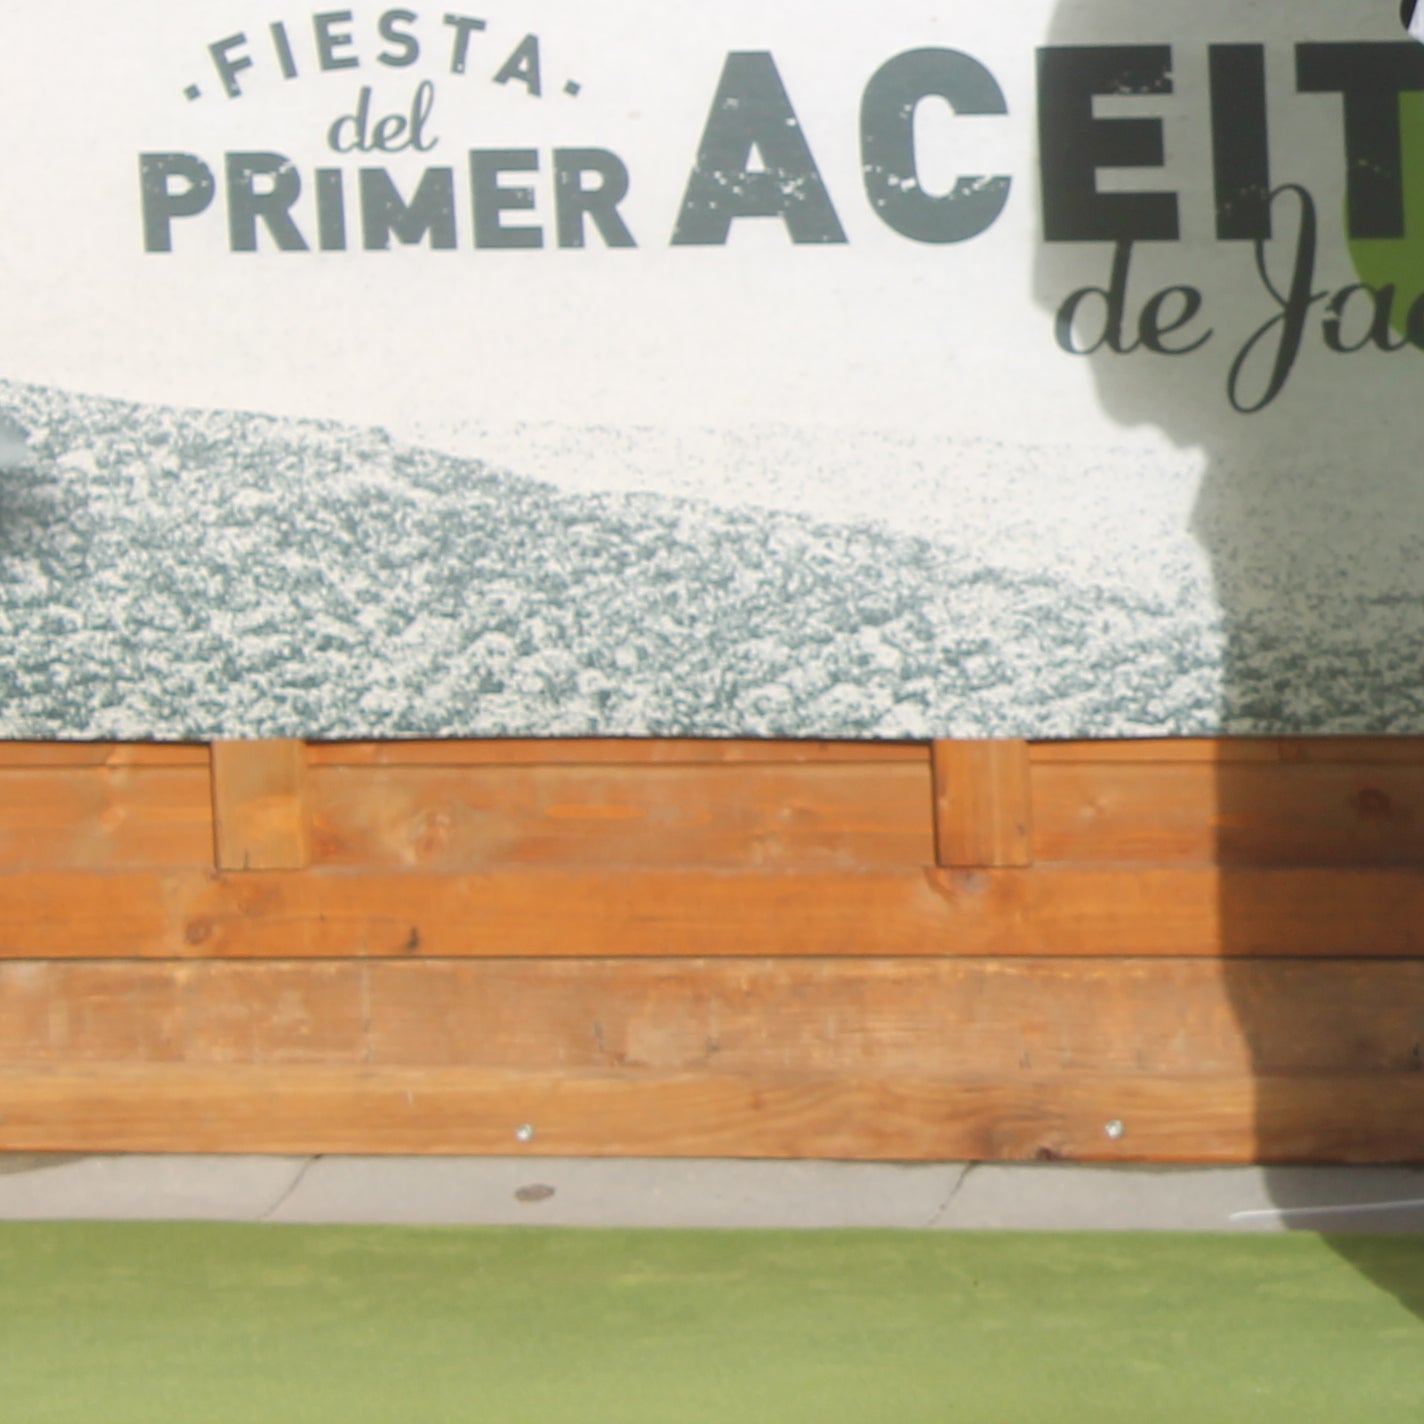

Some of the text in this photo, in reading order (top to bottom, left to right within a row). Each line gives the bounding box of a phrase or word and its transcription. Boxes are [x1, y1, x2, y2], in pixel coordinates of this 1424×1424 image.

[326, 79, 440, 154] del
[137, 147, 639, 253] PRIMER
[1054, 239, 1213, 357] de
